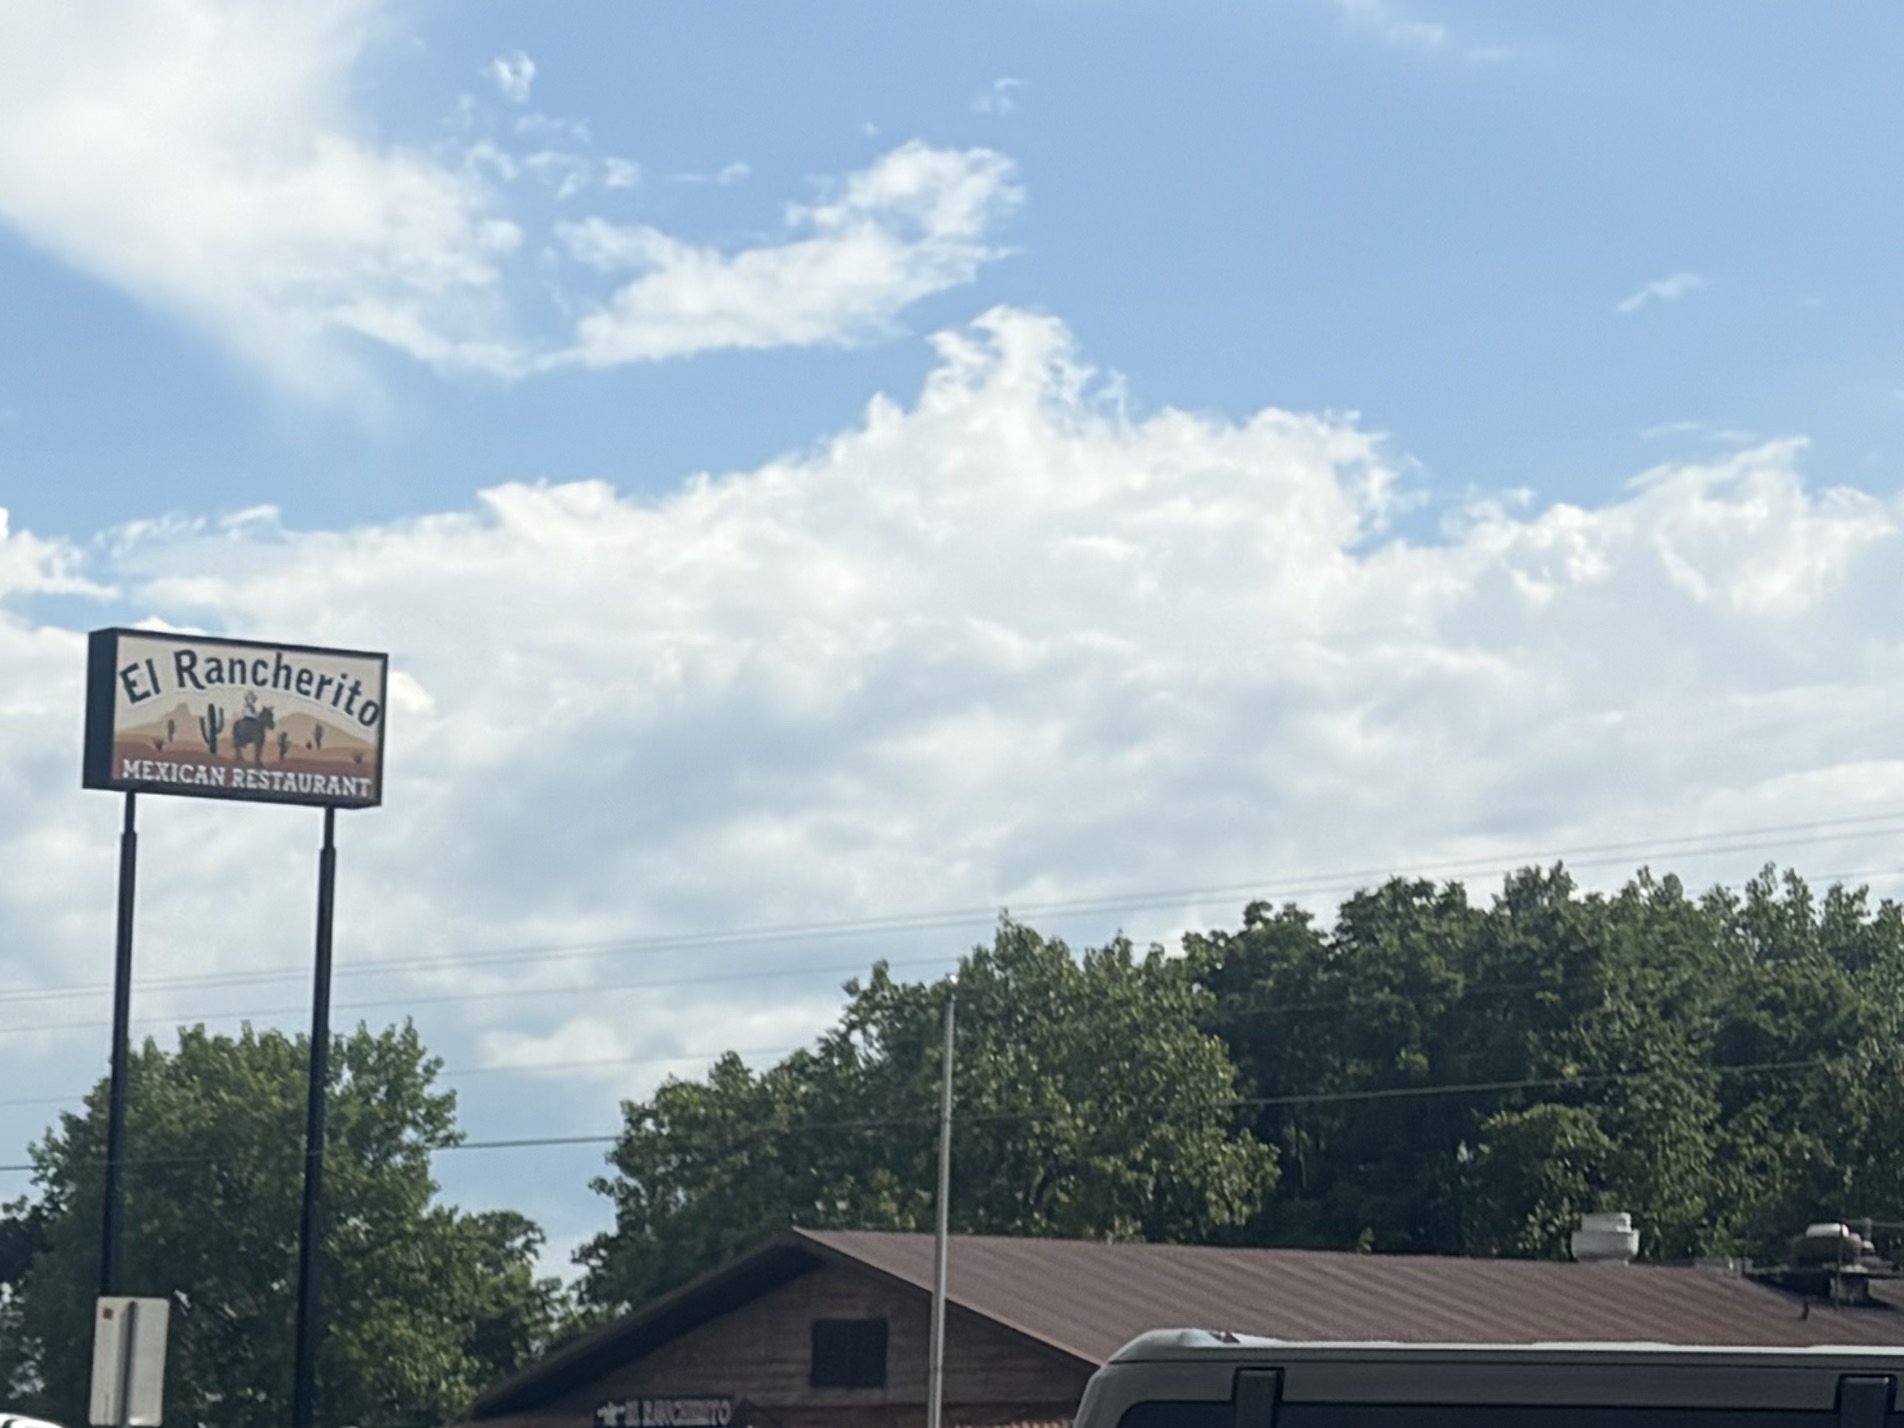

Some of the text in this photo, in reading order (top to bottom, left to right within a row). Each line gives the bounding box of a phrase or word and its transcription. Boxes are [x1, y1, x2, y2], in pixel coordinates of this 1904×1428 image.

[119, 649, 381, 728] El Rancherito
[122, 759, 373, 798] MEXICAN RESTAURANT
